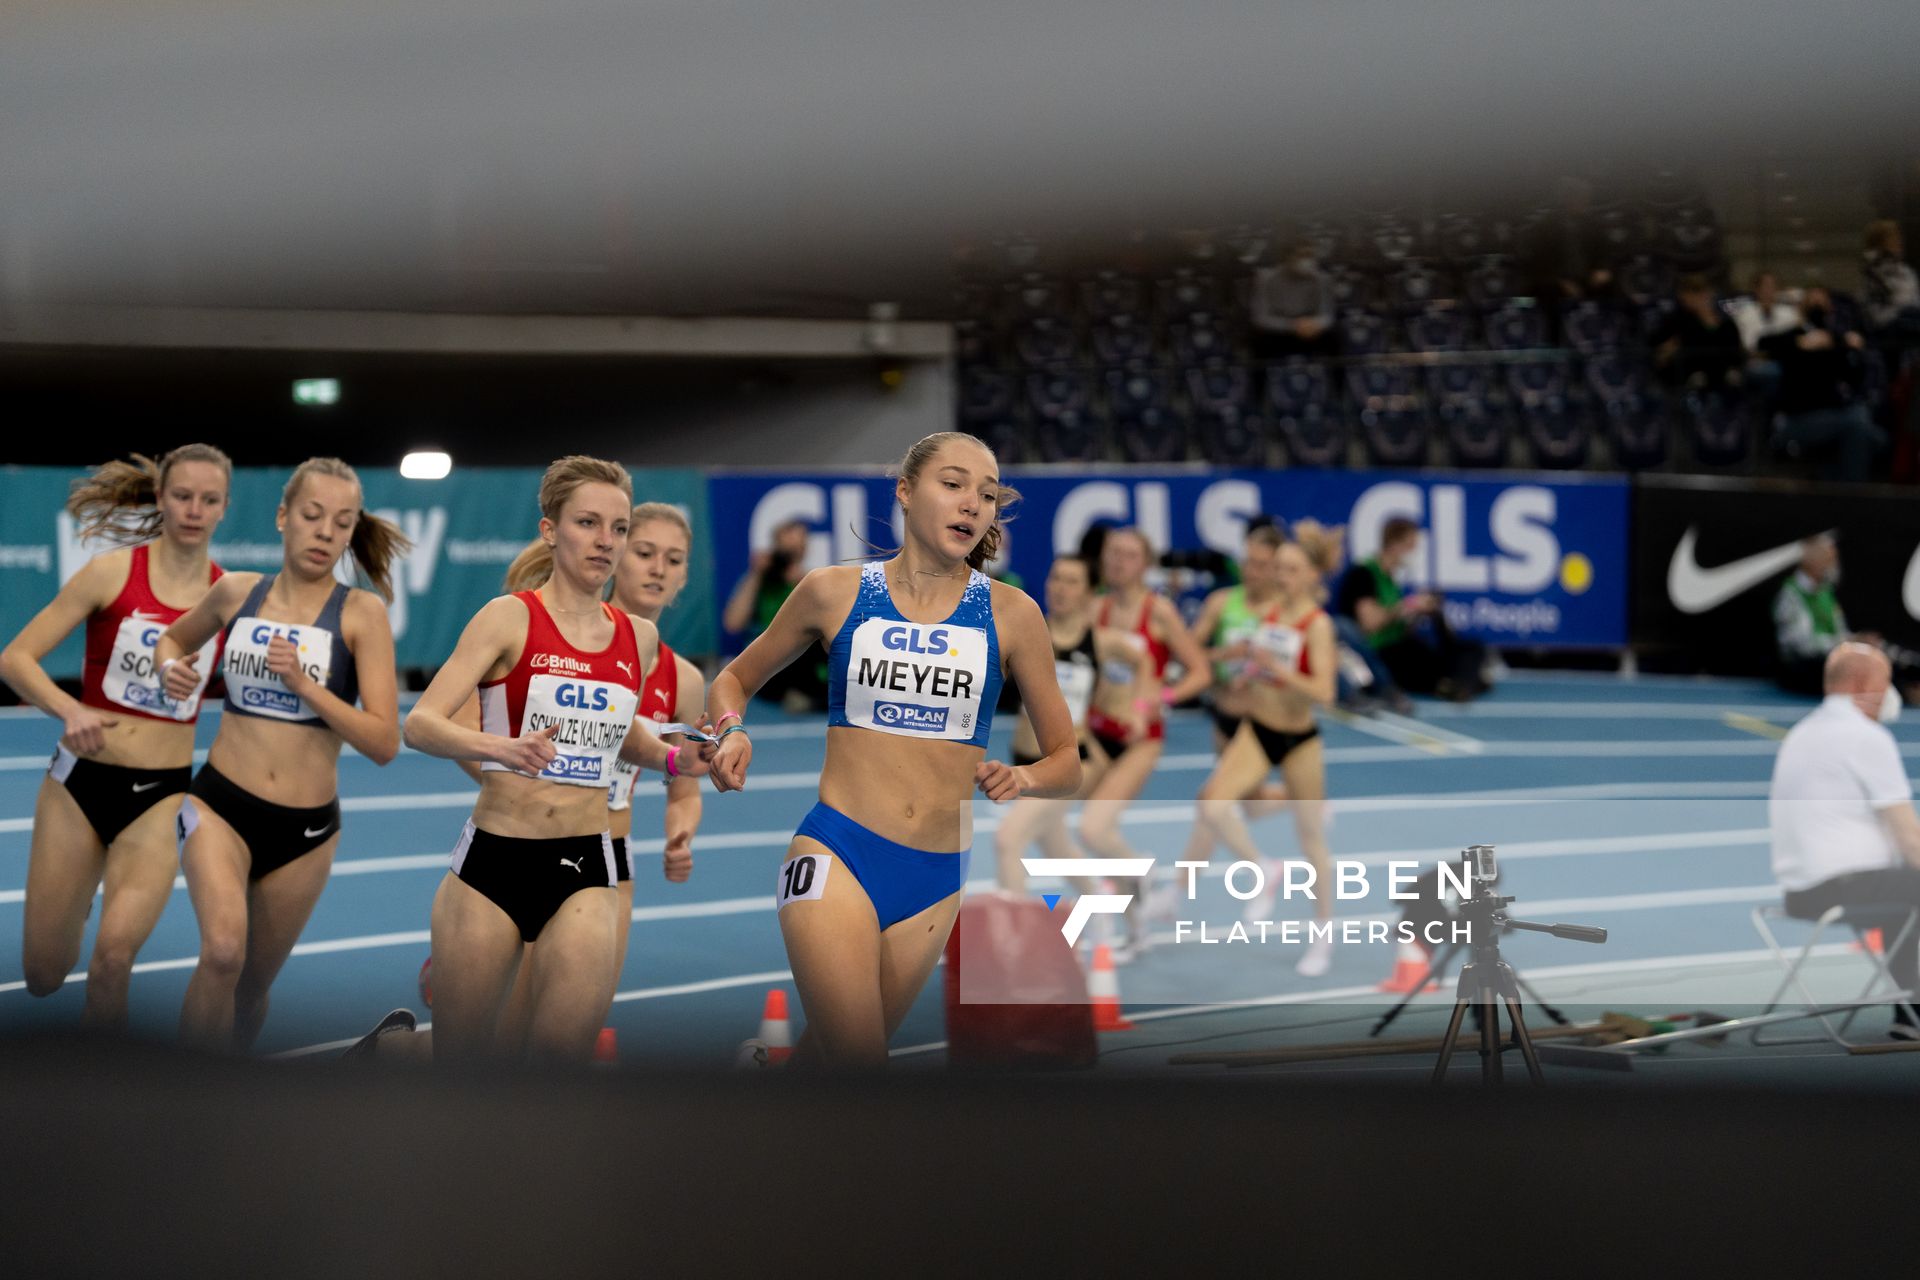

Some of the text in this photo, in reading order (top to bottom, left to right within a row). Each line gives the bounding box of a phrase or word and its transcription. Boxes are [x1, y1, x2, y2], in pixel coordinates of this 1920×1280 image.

[549, 654, 592, 674] Brillux
[548, 668, 577, 677] Münster
[858, 658, 973, 699] MEYER
[904, 707, 945, 723] PLAN
[961, 713, 971, 729] 399
[903, 721, 943, 729] INTERNATIONAL
[580, 720, 627, 749] KALTHOFF
[570, 760, 600, 773] PLAN
[784, 856, 816, 900] 10
